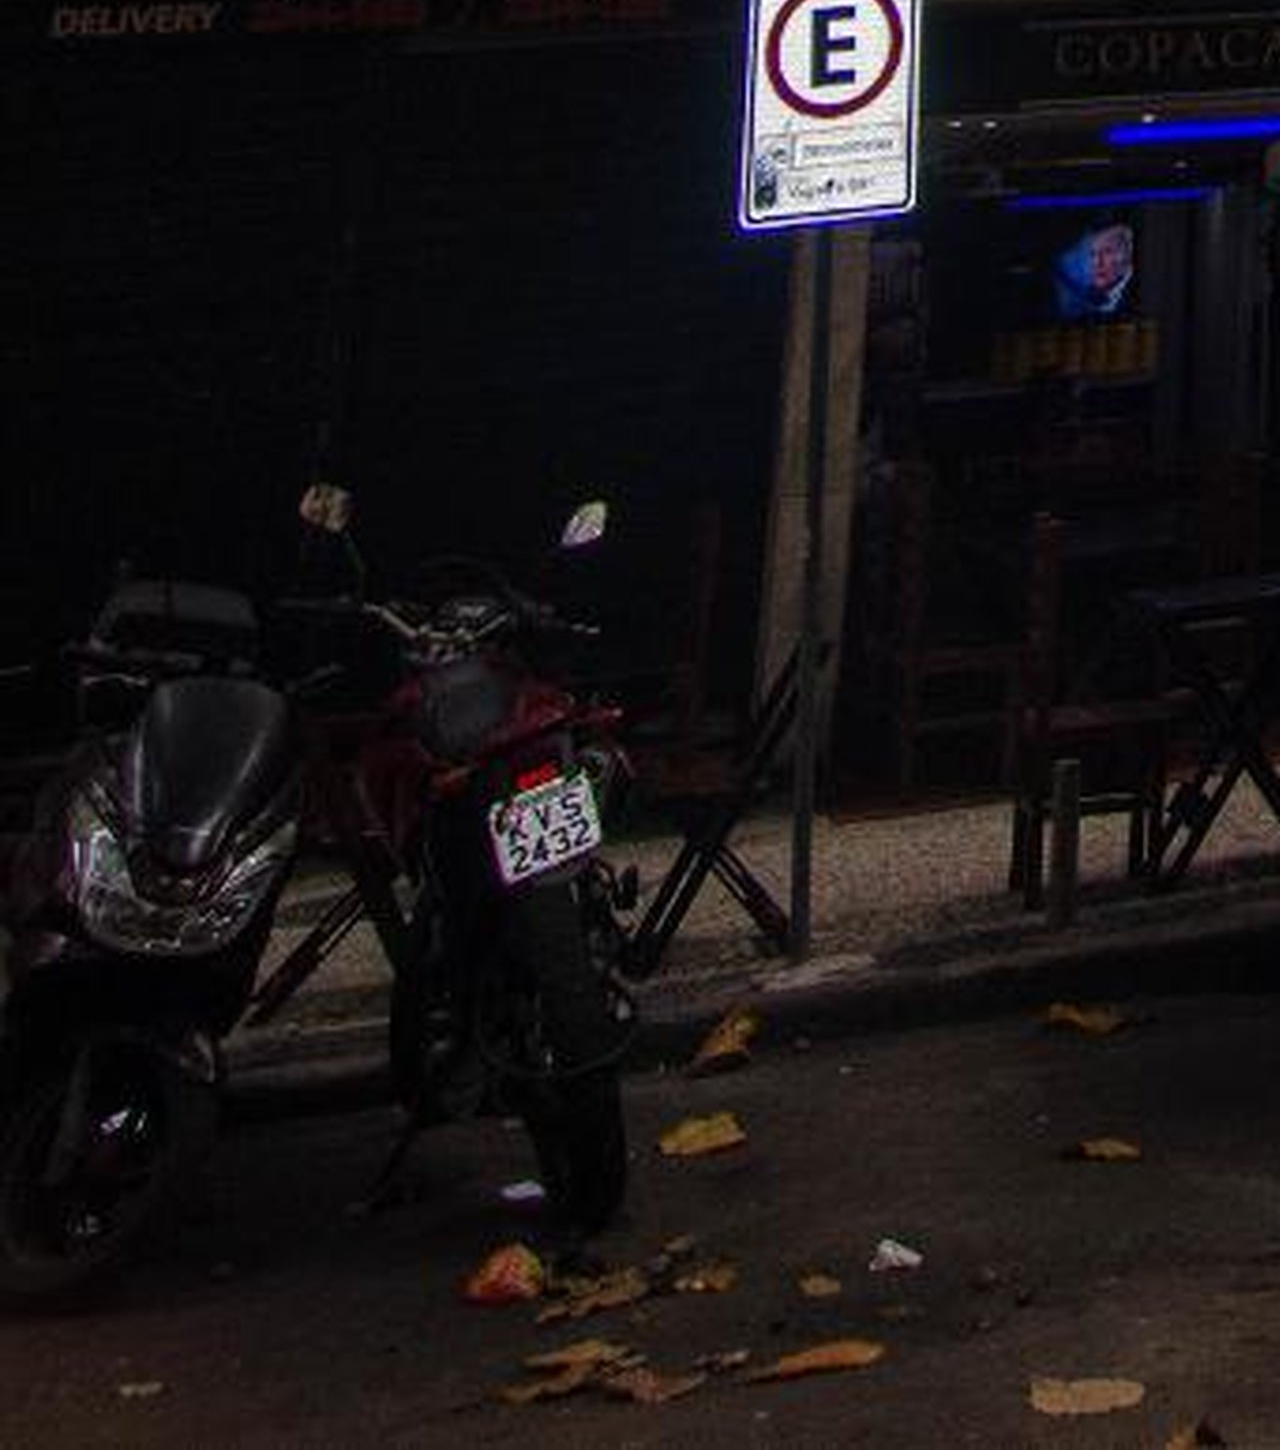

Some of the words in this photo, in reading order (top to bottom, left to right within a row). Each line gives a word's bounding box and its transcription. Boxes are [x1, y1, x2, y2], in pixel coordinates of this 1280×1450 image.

[50, 0, 223, 37] DELIVERY
[810, 5, 856, 88] E
[509, 815, 593, 874] 2432
